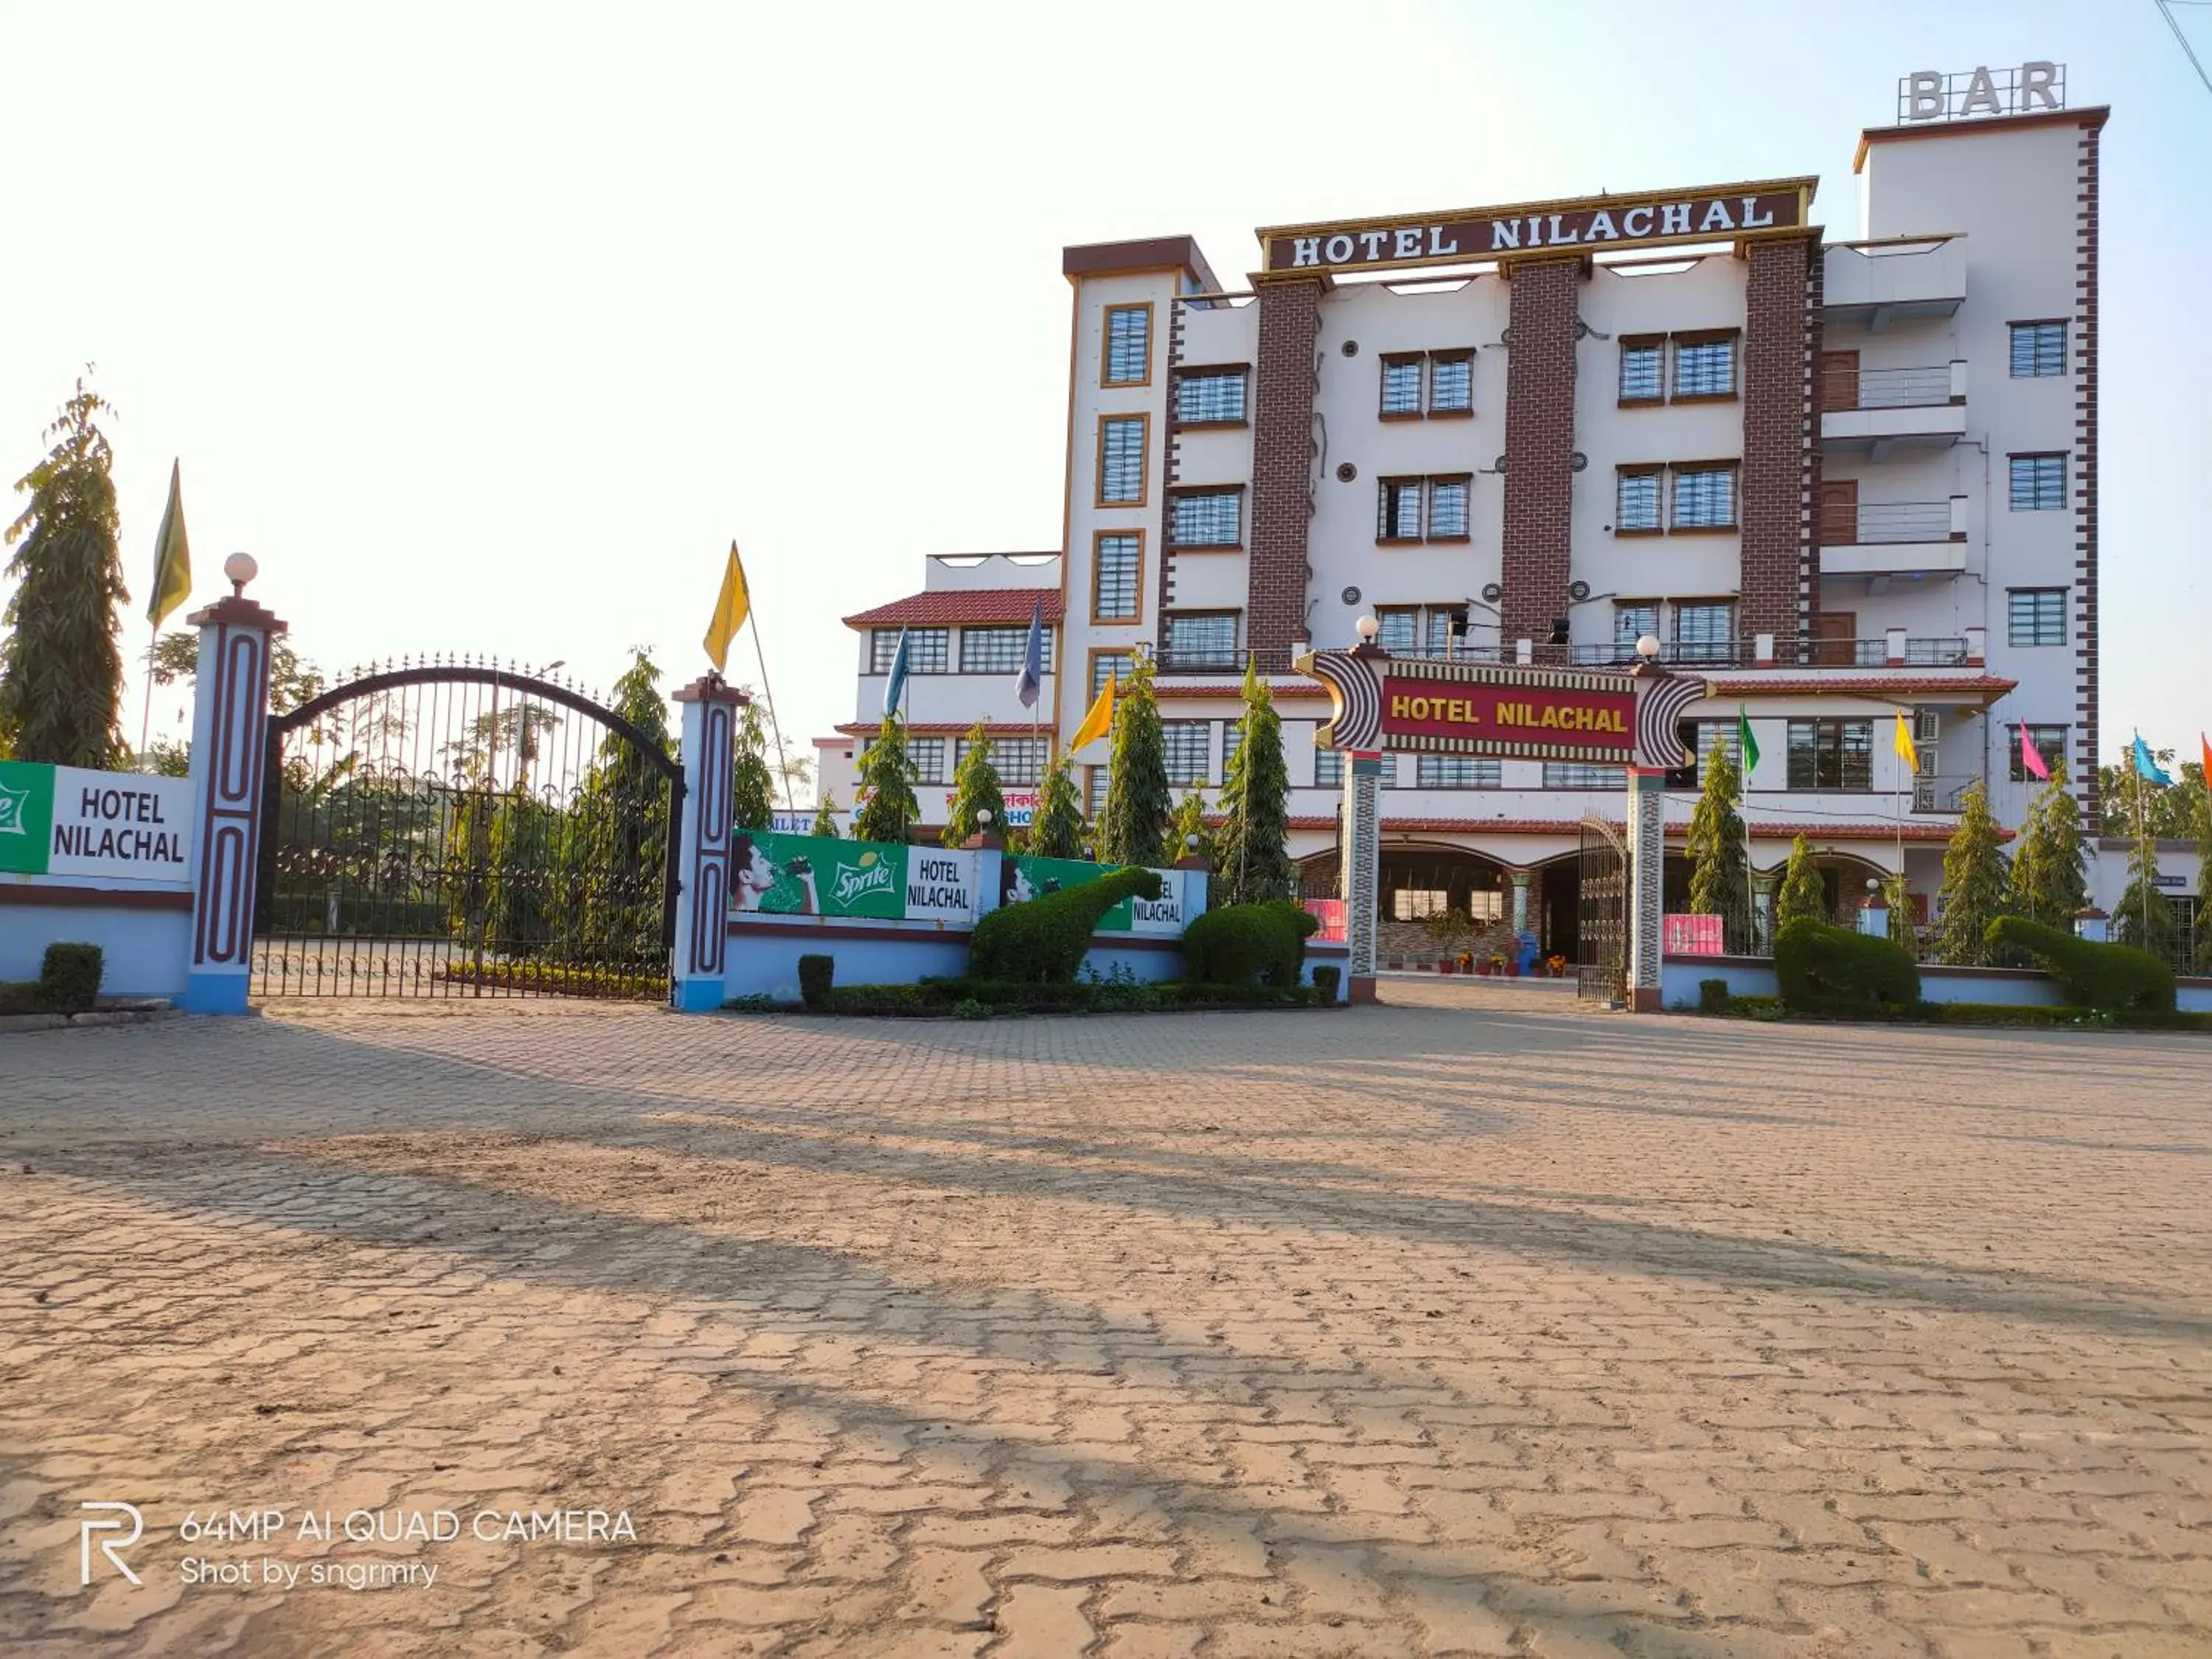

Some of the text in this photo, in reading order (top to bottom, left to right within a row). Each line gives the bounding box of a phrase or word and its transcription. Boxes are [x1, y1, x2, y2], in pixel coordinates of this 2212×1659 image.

[1909, 60, 2059, 120] BAR
[1293, 196, 1773, 267] HOTEL NILACHAL
[1391, 695, 1629, 733] HOTEL NILACHAL
[80, 787, 165, 824] HOTEL
[54, 824, 185, 863] NILACHAL
[837, 861, 889, 899] Sprite
[920, 859, 960, 883] HOTEL
[908, 885, 969, 909] NILACHAL
[1133, 902, 1180, 922] NILACHAL
